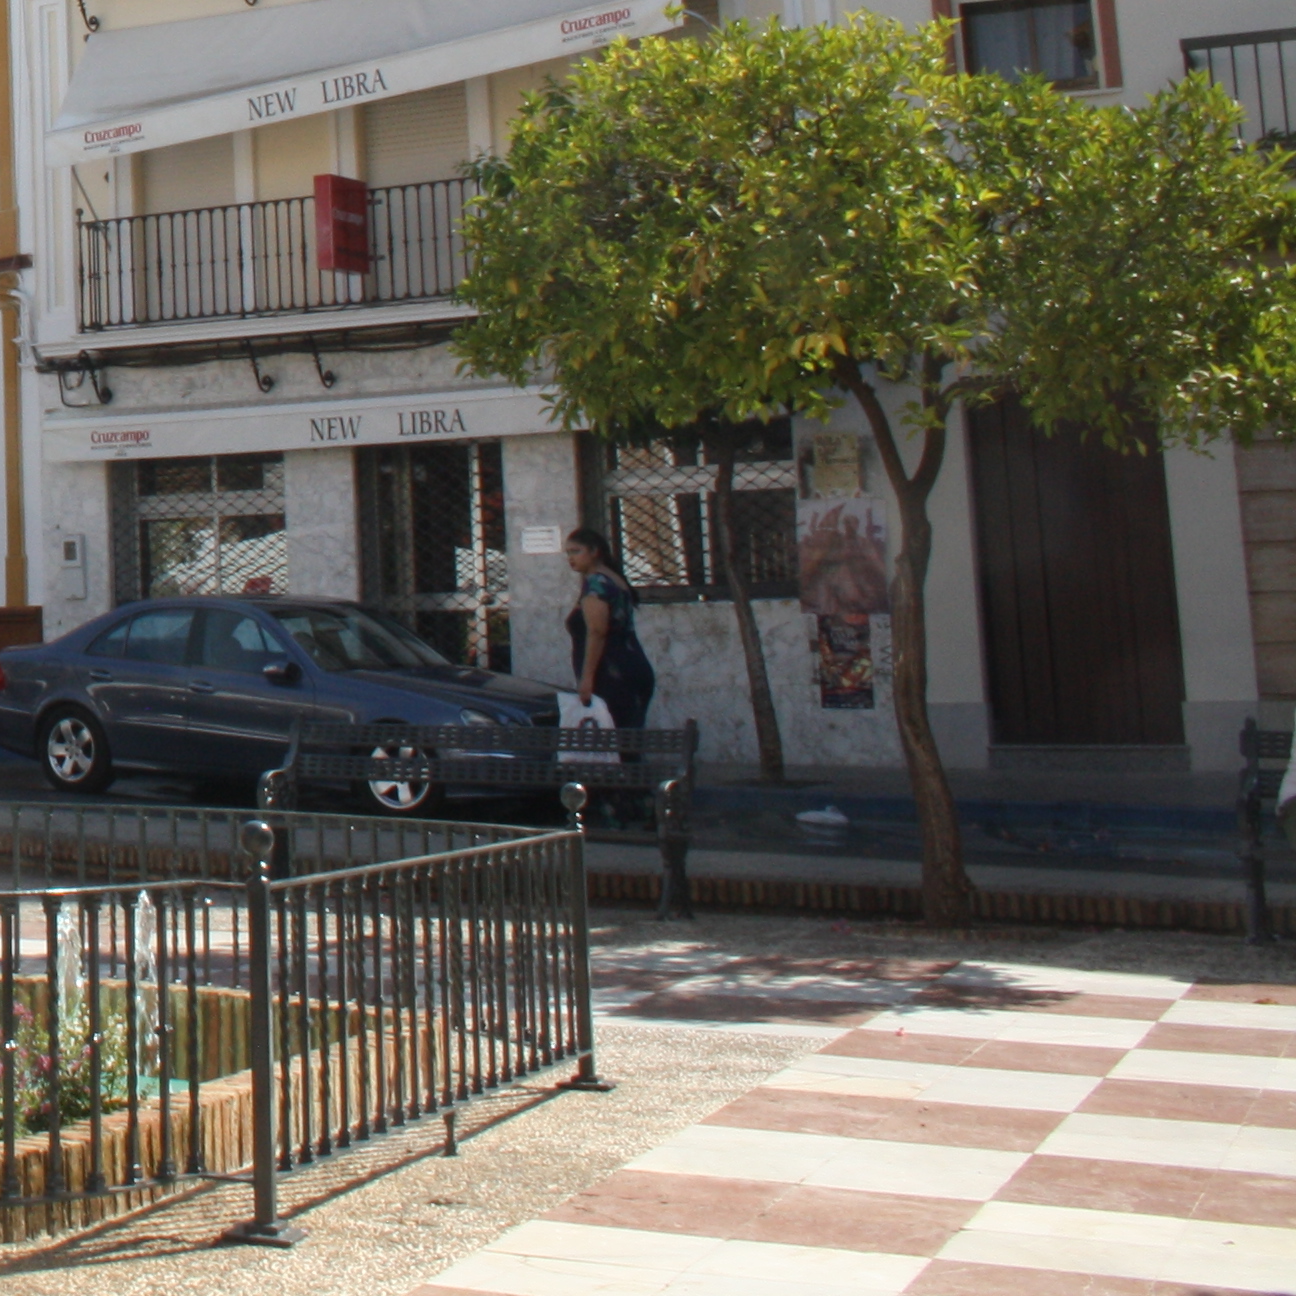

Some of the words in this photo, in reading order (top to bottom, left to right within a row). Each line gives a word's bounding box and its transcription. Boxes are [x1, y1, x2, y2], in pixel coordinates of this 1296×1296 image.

[560, 8, 631, 35] Cruzcampo
[247, 87, 297, 121] NEW
[321, 68, 388, 104] LIBRA
[83, 122, 143, 144] Cruzcampo
[90, 429, 150, 444] Cruzcampo
[310, 414, 362, 442] NEW
[398, 408, 467, 436] LIBRA
